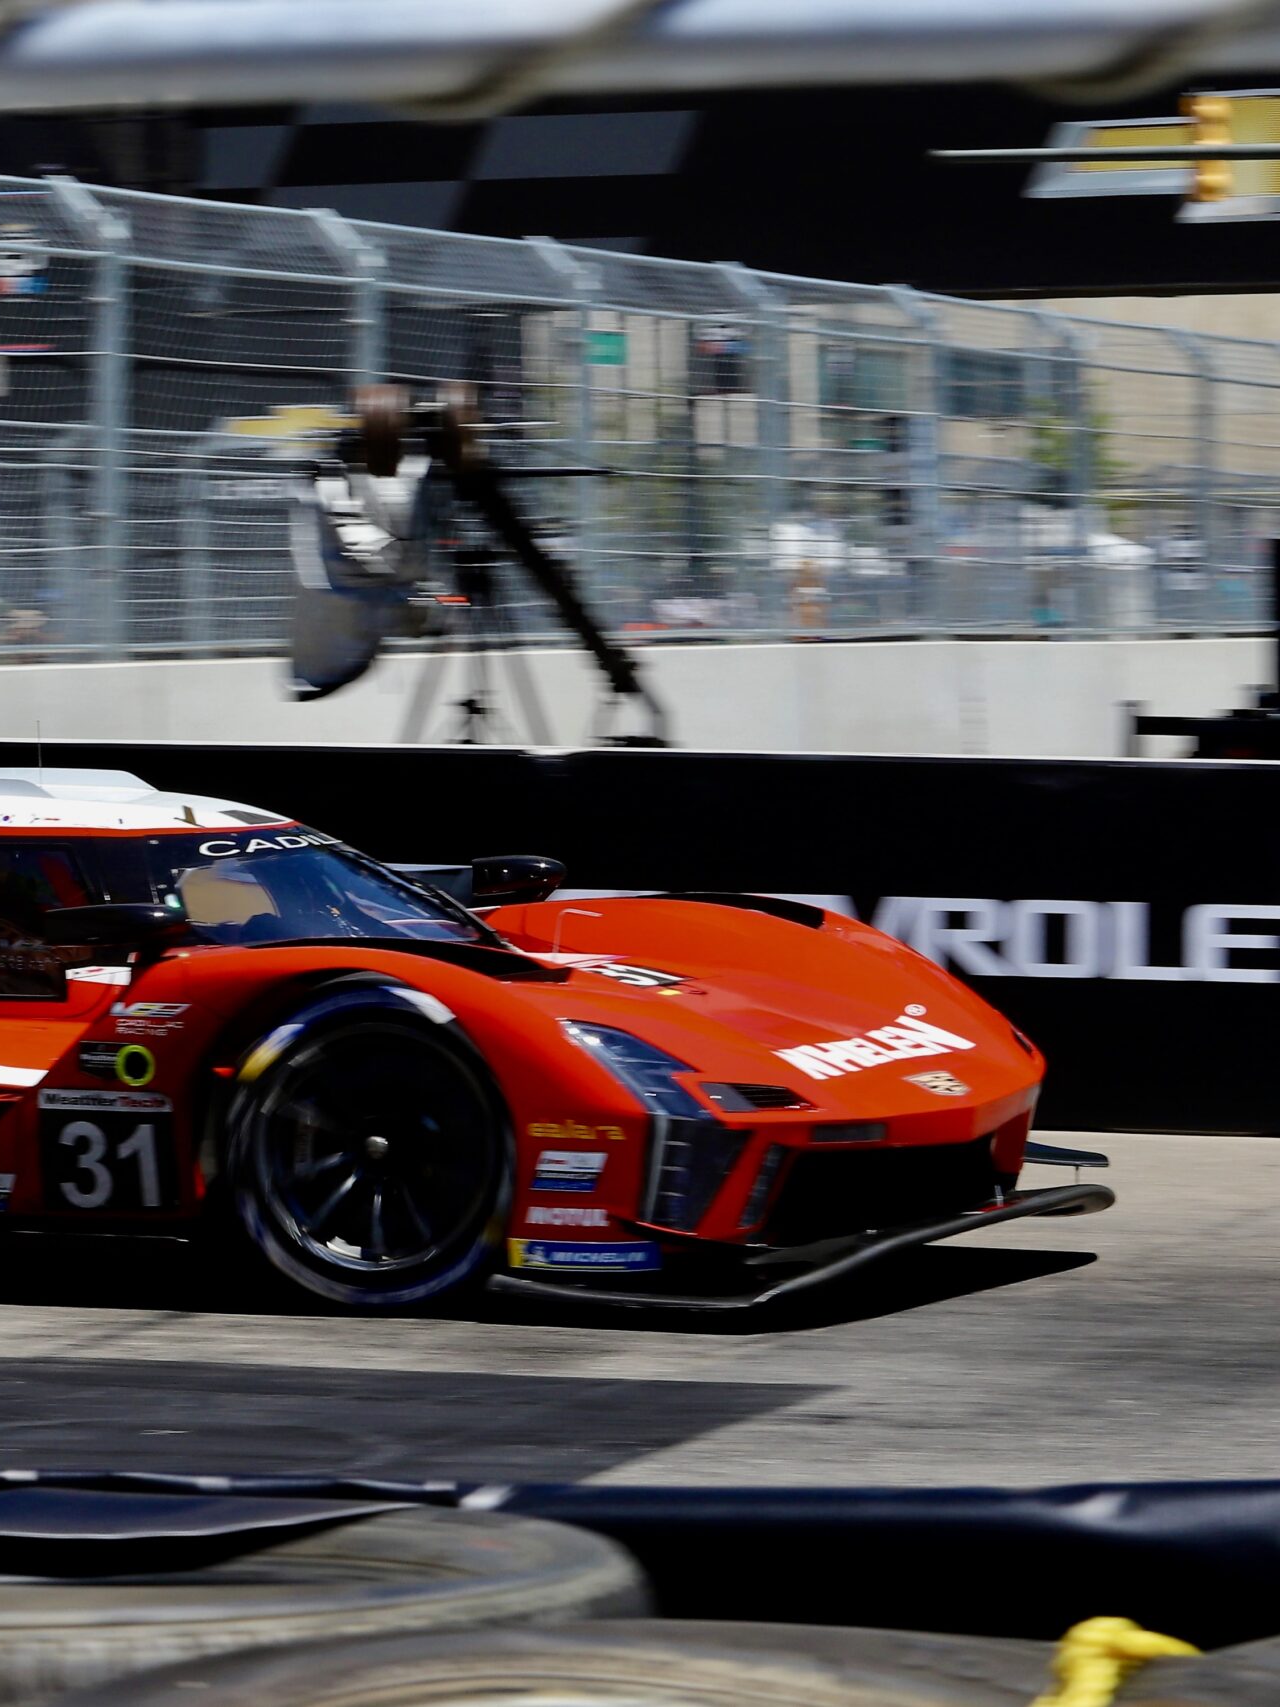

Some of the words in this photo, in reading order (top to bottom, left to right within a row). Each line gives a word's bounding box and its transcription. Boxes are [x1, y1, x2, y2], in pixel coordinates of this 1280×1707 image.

[59, 1121, 161, 1209] 31
[524, 1206, 611, 1227] MOTUL
[548, 1251, 648, 1263] MICHELIN
